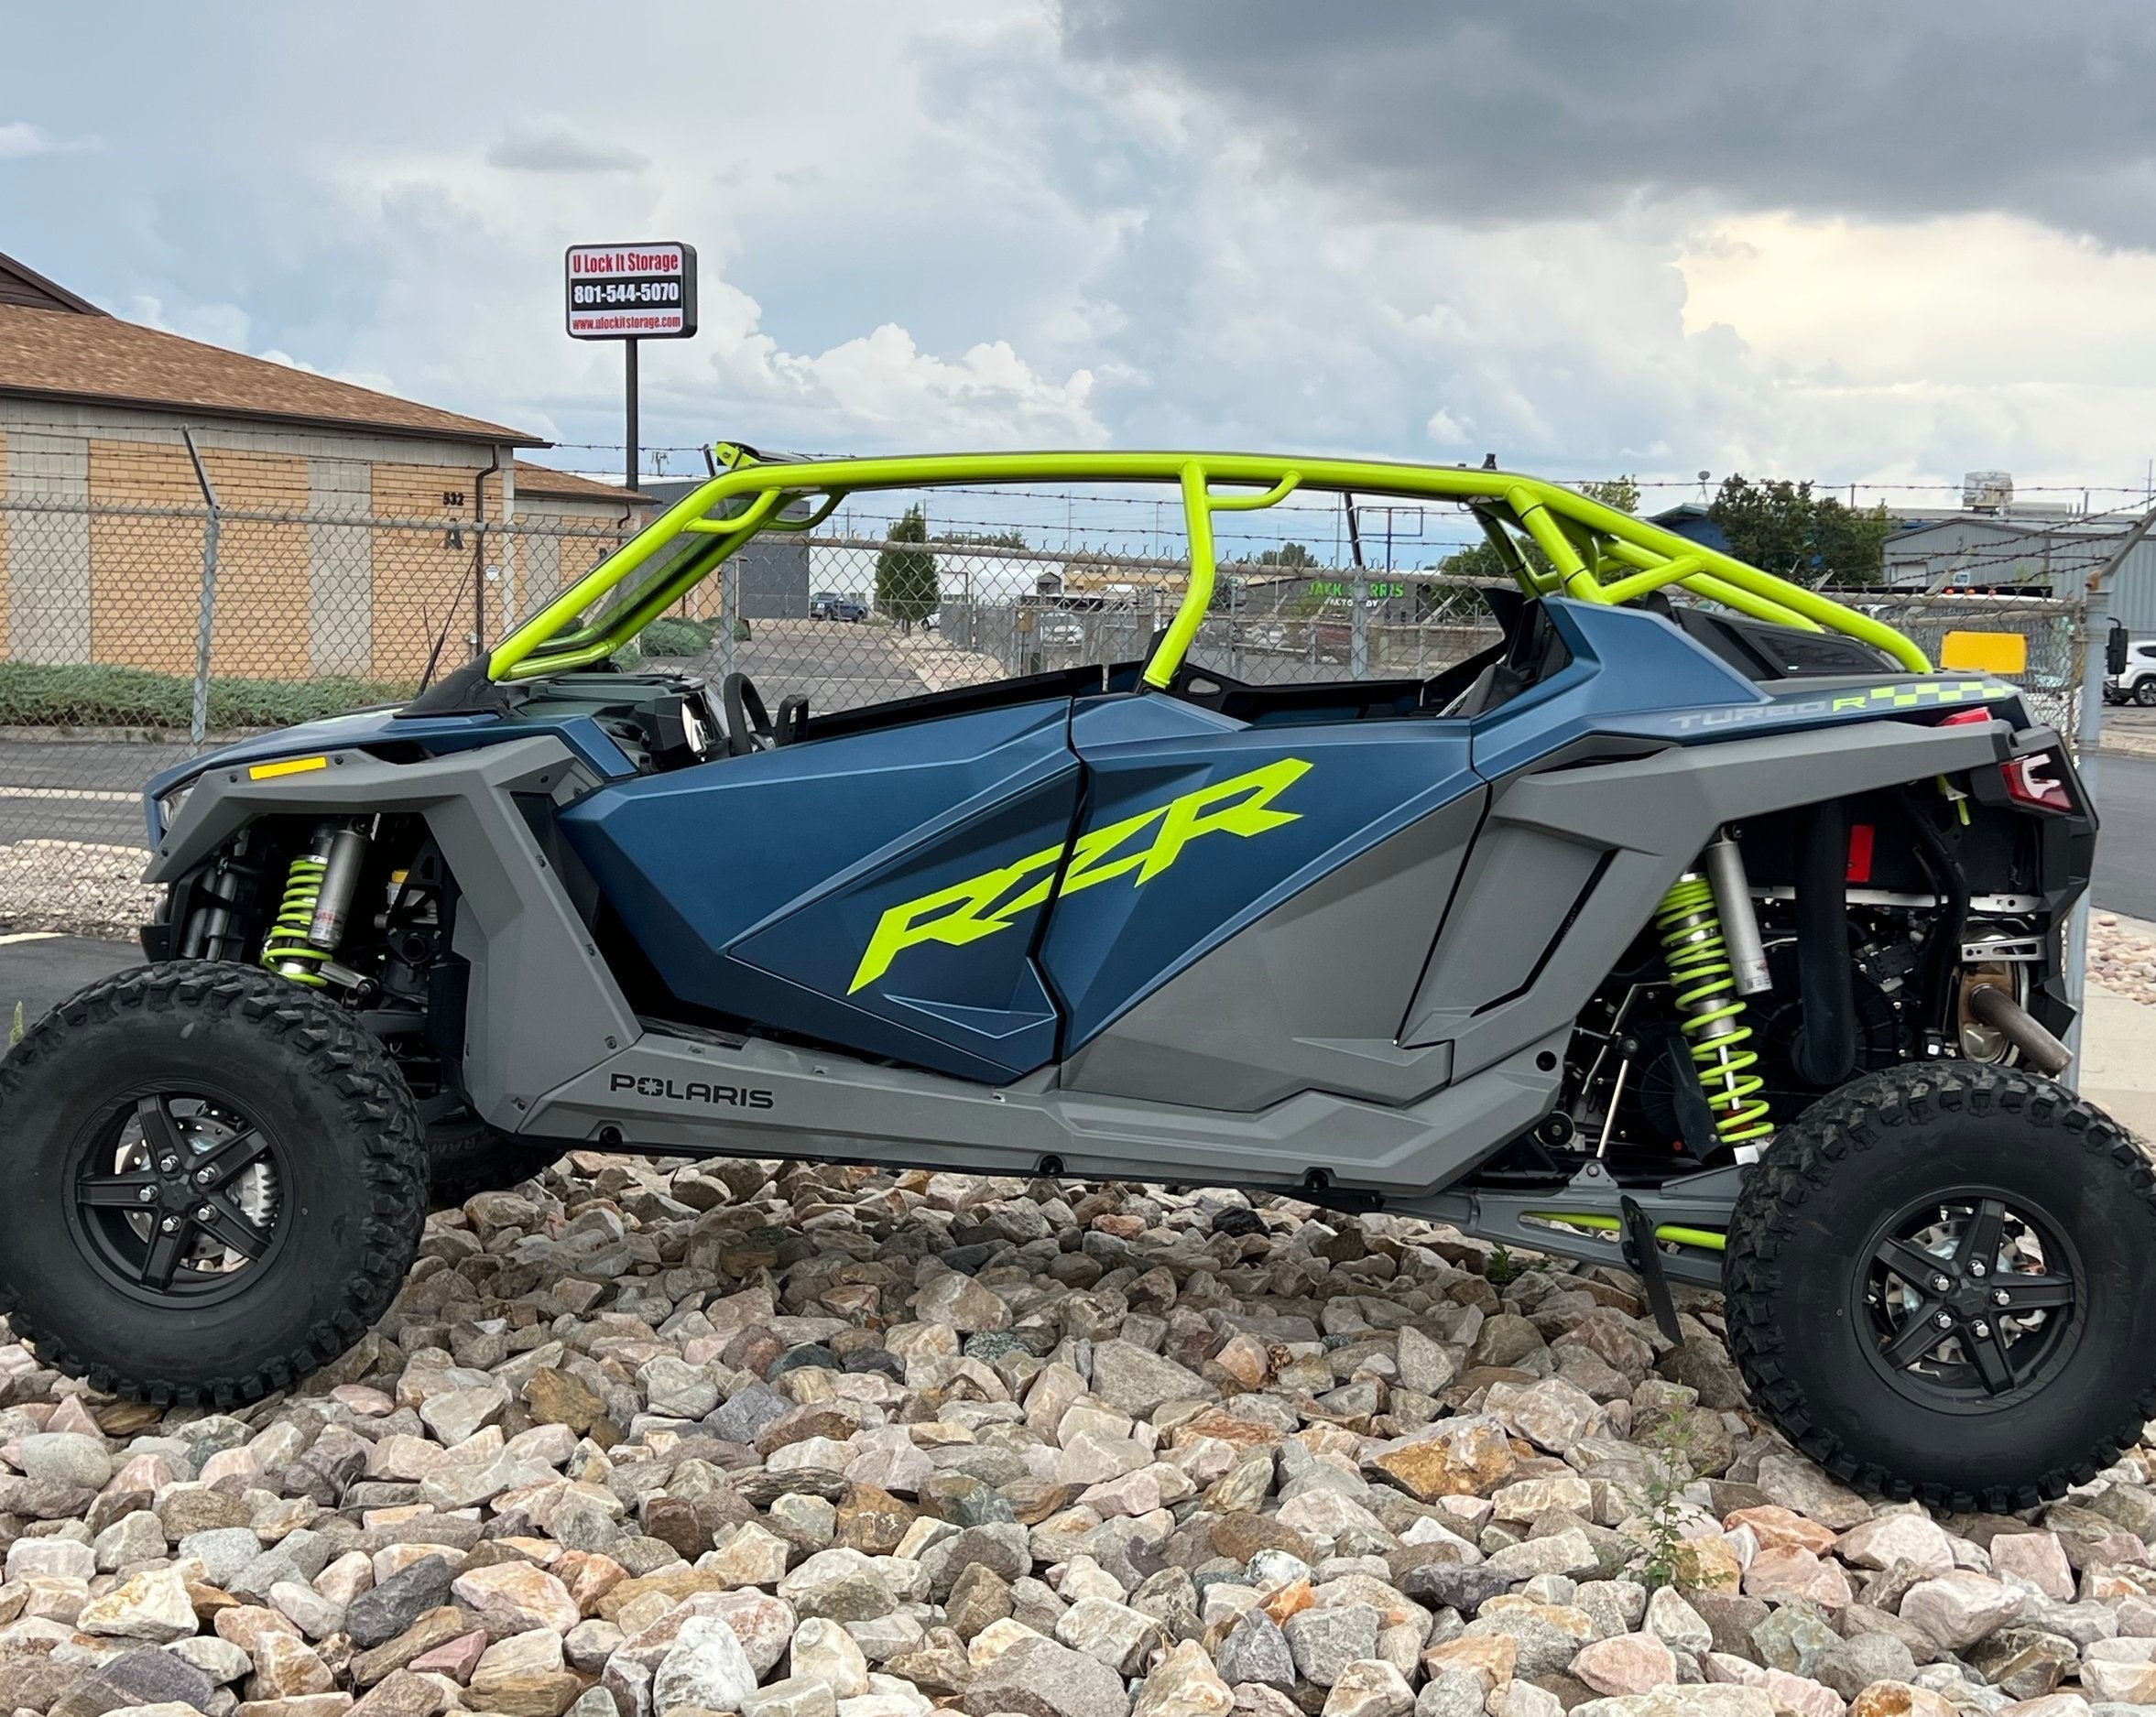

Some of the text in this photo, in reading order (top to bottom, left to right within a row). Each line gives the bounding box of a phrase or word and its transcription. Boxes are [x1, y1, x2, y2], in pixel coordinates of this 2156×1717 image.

[573, 253, 679, 273] U Lock It Storage
[574, 282, 680, 303] 801-544-5070
[572, 316, 681, 330] www.ulockitstorage.com
[443, 492, 464, 505] 532
[1308, 581, 1343, 596] JACK
[1670, 696, 1867, 729] TURBO R
[847, 757, 1313, 995] RZR
[610, 1073, 774, 1109] POLARIS
